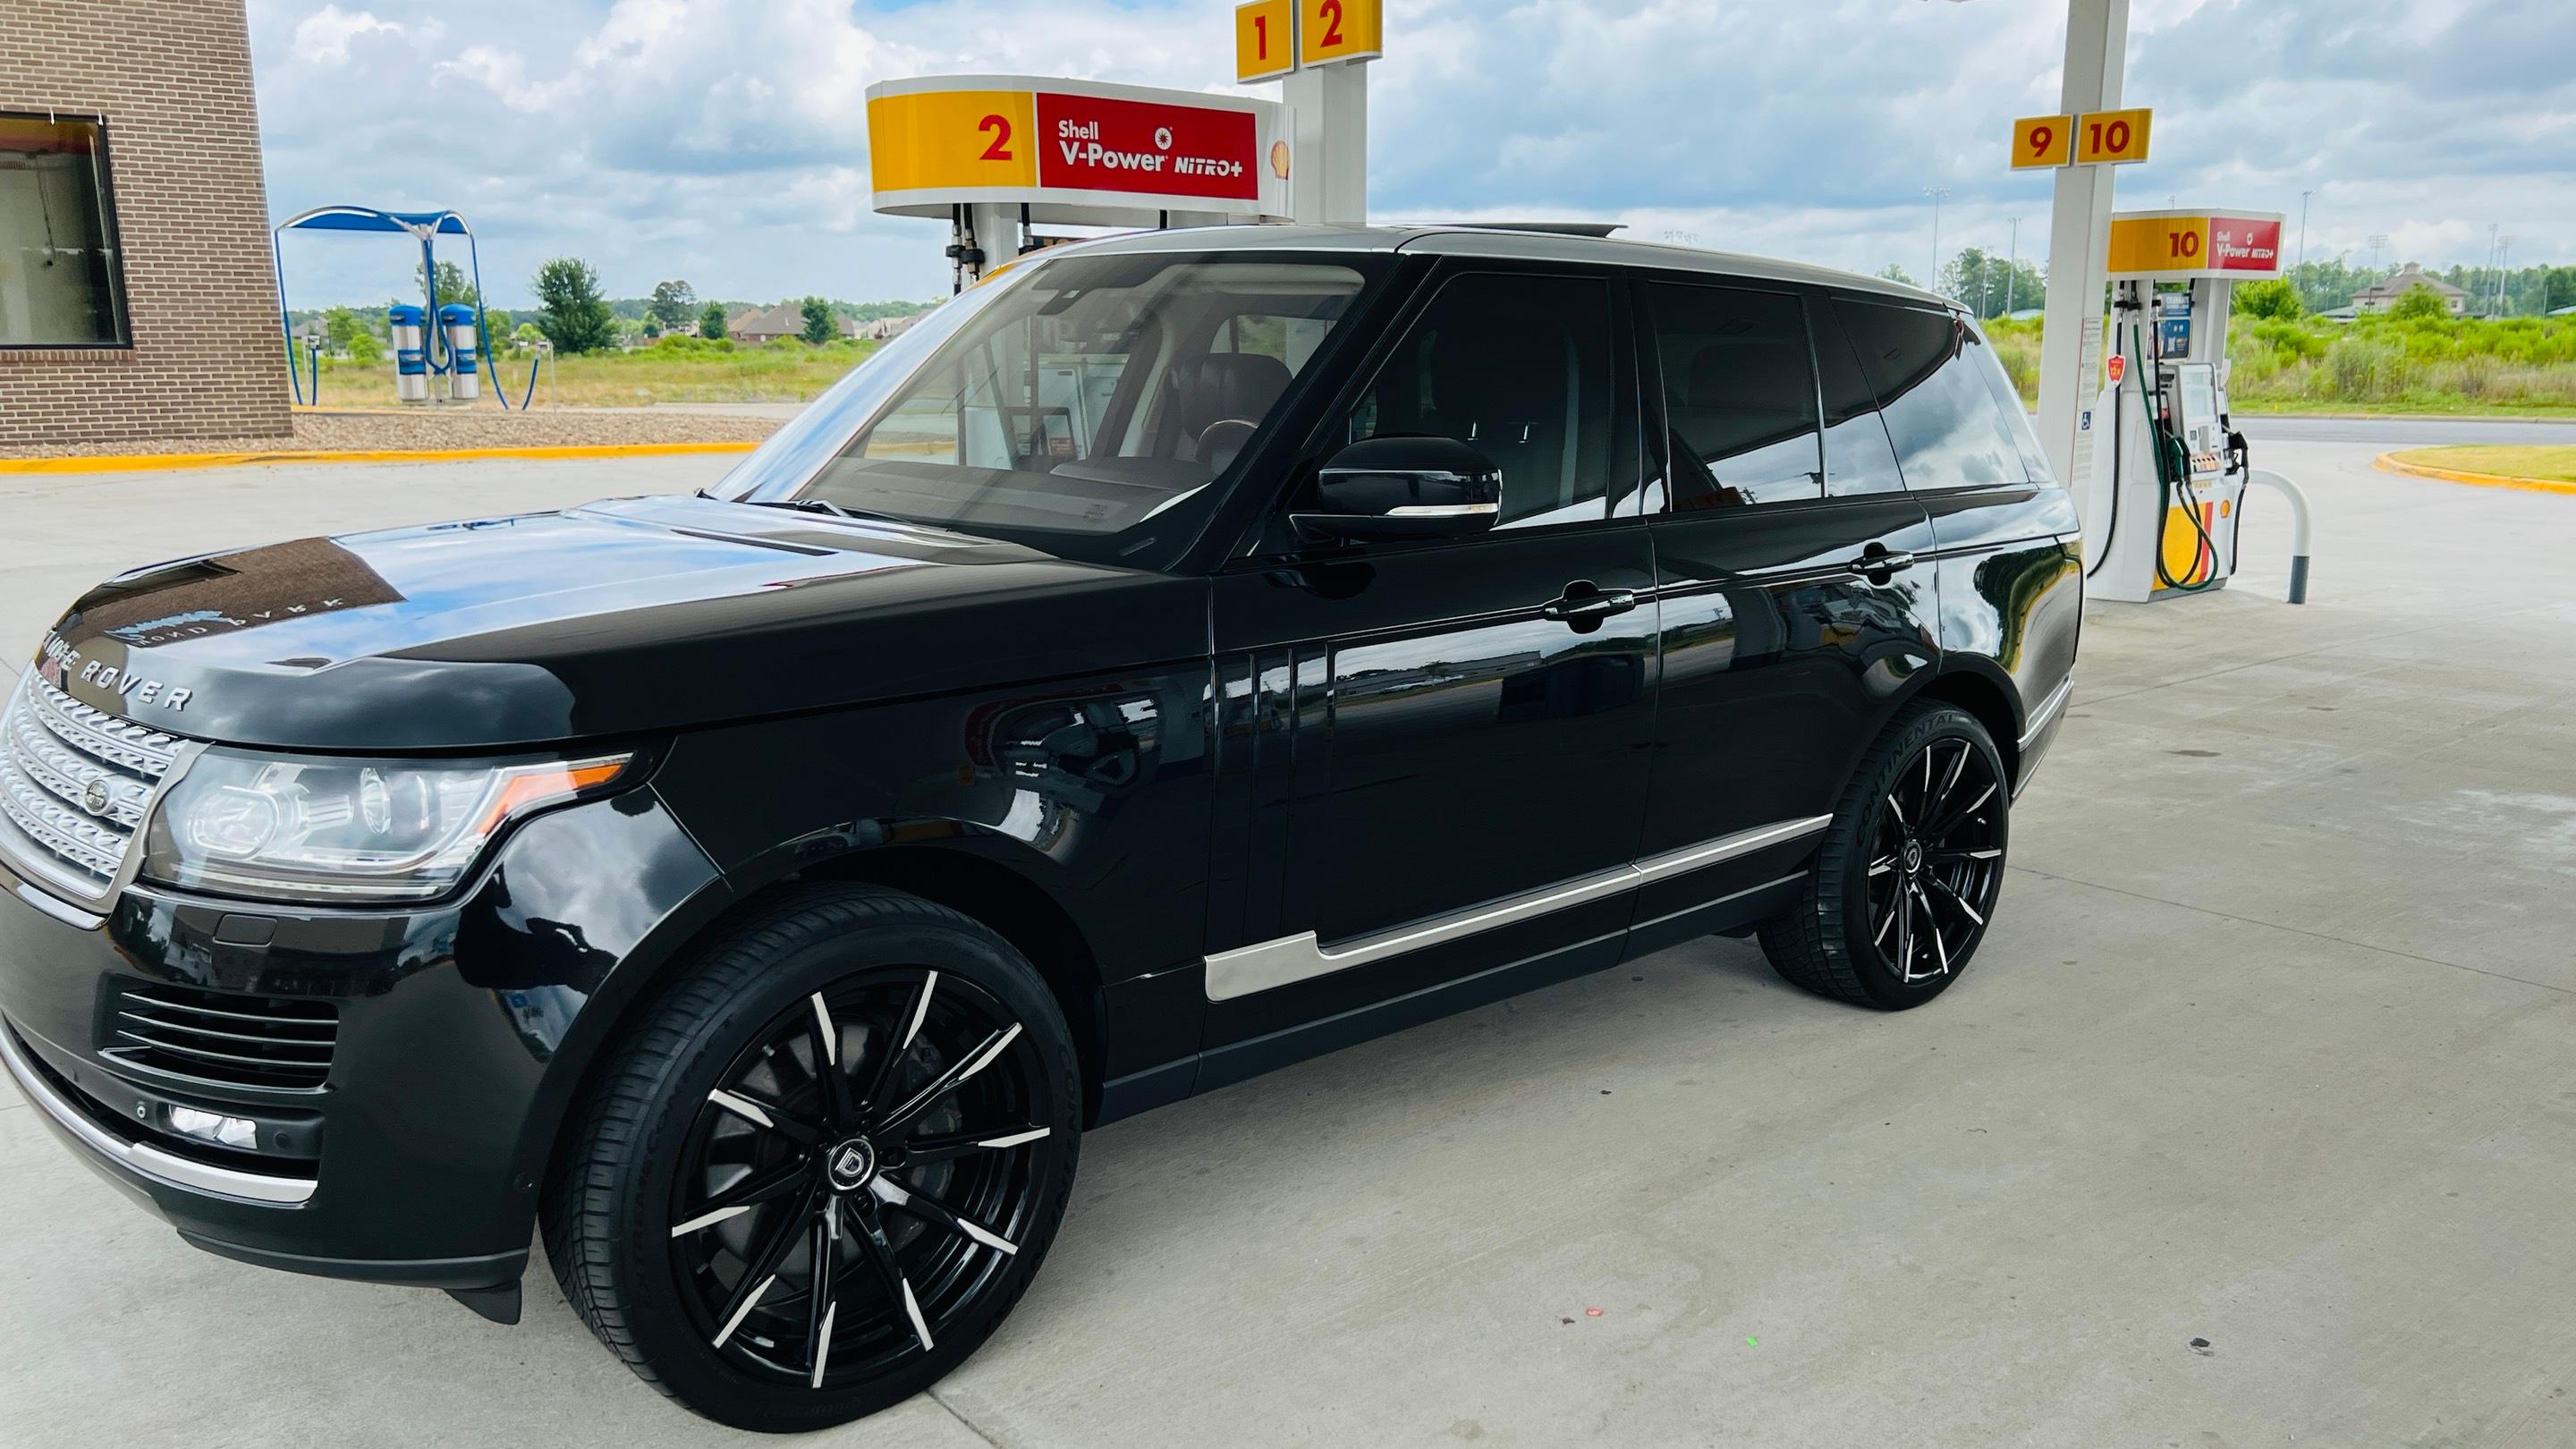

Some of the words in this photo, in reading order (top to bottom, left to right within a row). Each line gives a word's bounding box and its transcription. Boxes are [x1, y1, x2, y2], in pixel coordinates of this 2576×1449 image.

[1255, 15, 1267, 61] 1
[1319, 0, 1343, 48] 2
[979, 114, 1013, 161] 2
[1058, 119, 1099, 140] Shell
[2029, 126, 2053, 157] 9
[2089, 120, 2131, 154] 10
[2169, 231, 2199, 258] 10
[2216, 231, 2230, 242] Shell
[80, 659, 193, 712] ROVER
